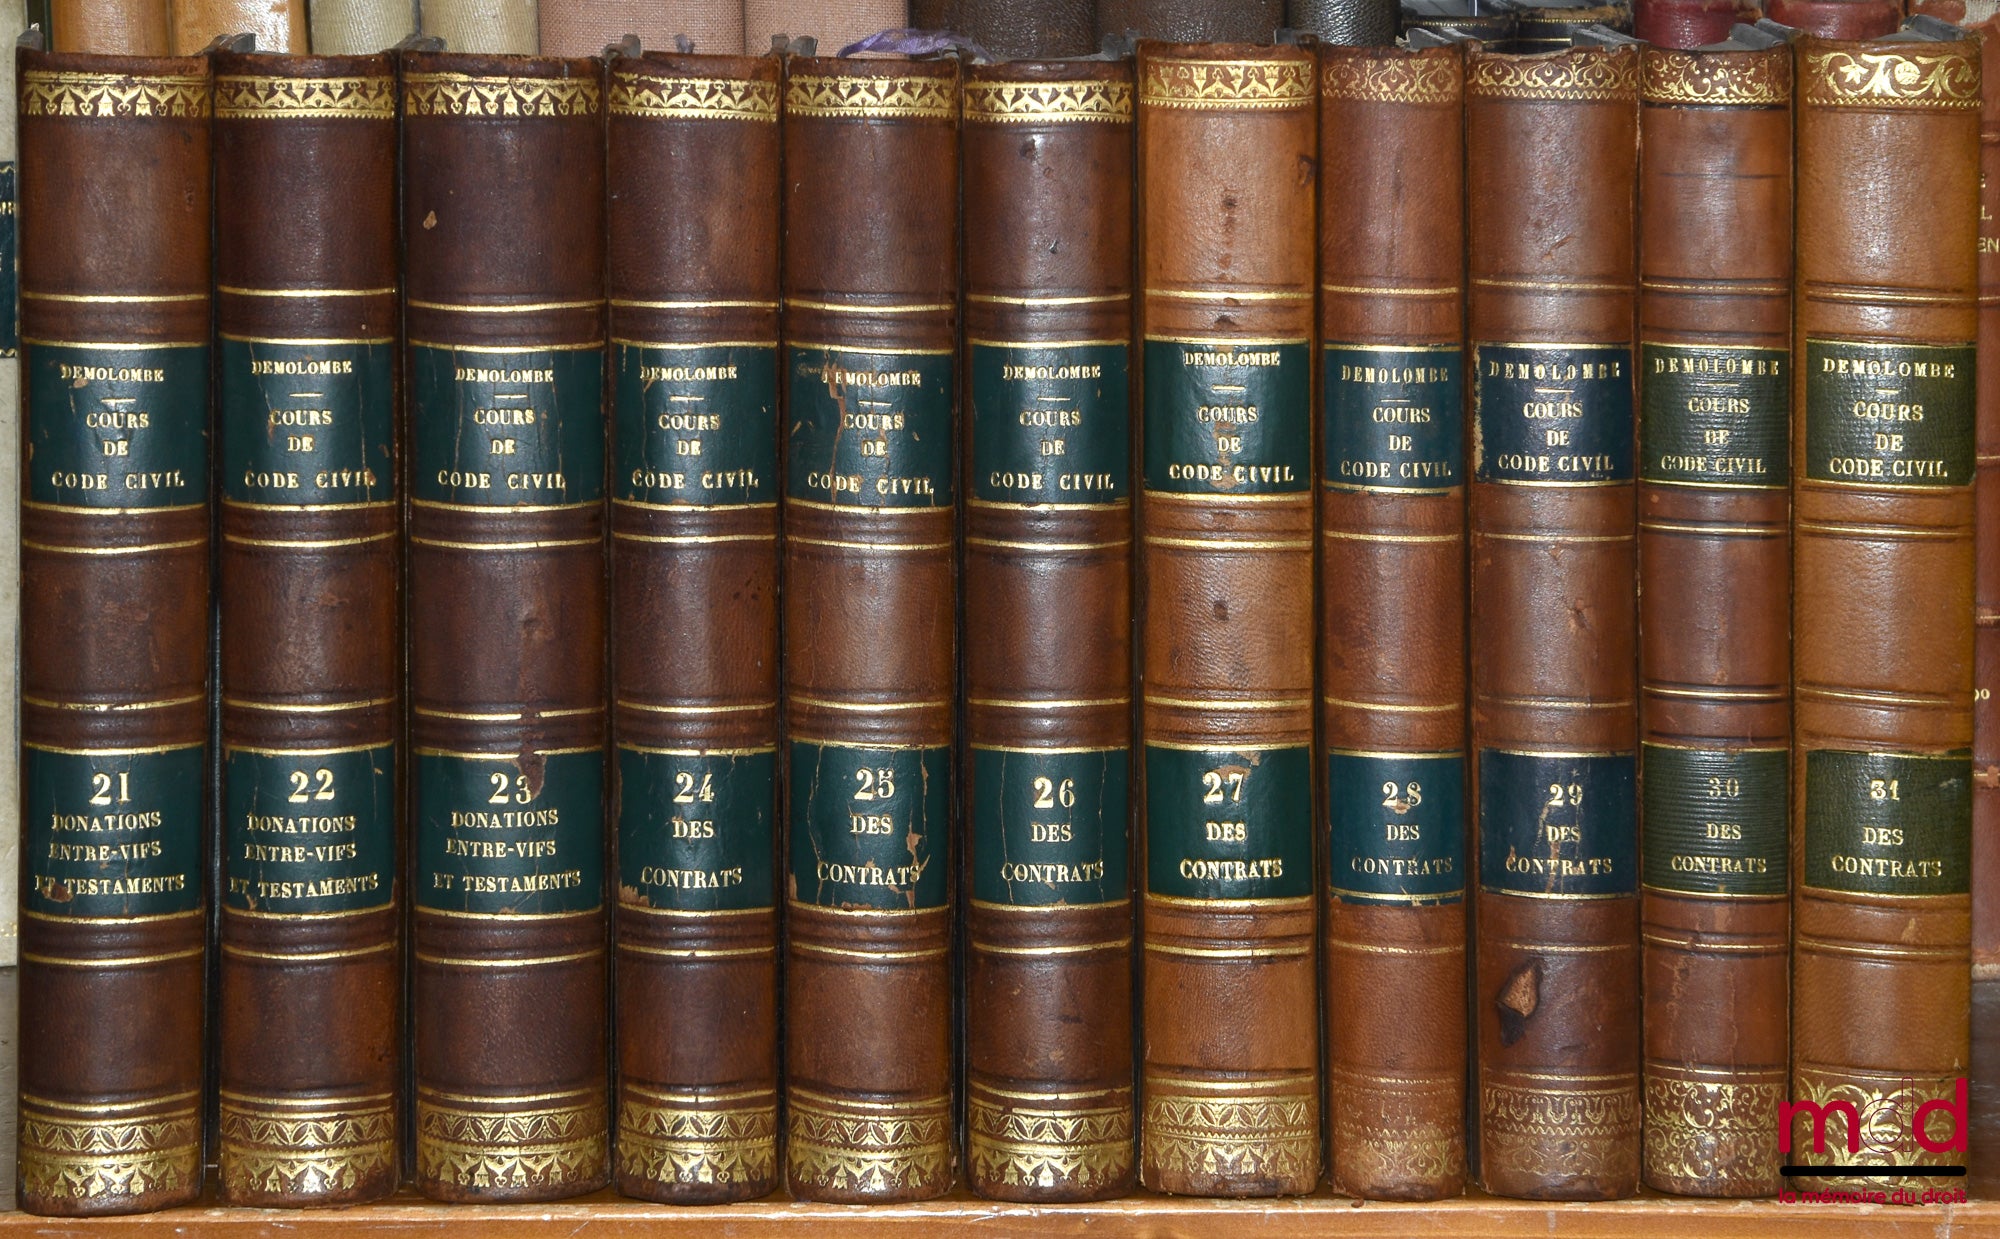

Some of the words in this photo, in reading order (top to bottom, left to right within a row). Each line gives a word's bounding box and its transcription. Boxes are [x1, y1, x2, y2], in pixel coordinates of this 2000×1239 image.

[252, 361, 352, 375] DEMOLOMBE
[1184, 352, 1280, 366] DEMOLOMBE
[1655, 358, 1778, 375] DEMOLOMBE
[1823, 358, 1954, 378] DEMOLOMBE
[61, 366, 164, 382] DEMOLOMBE
[455, 368, 553, 383] DEMOLOMBE
[640, 367, 737, 381] DEMOLOMBE
[1003, 366, 1101, 380] DEMOLOMBE
[1342, 365, 1448, 383] DEMOLOMBE
[1488, 361, 1620, 380] DEMOLOMBE
[1198, 406, 1258, 422] COURS
[1523, 402, 1583, 418] COURS
[1688, 397, 1750, 413] COURS
[1853, 401, 1923, 421] COURS
[86, 413, 149, 428] COURS
[270, 410, 332, 425] COURS
[474, 409, 535, 424] COURS
[658, 415, 720, 430] COURS
[844, 414, 904, 430] COURS
[1019, 411, 1081, 426] COURS
[1373, 408, 1430, 423] COURS
[288, 436, 314, 452] DE
[1218, 437, 1241, 452] DE
[1389, 435, 1412, 451] DE
[1547, 430, 1570, 446] DE
[1705, 430, 1729, 444] DE
[1876, 433, 1903, 451] DE
[103, 440, 128, 456] DE
[490, 439, 516, 454] DE
[677, 441, 701, 455] DE
[862, 441, 886, 455] DE
[1041, 440, 1065, 455] DE
[1341, 461, 1390, 478] CODE
[1400, 462, 1451, 478] CIVIL
[1498, 455, 1550, 472] CODE
[1558, 456, 1613, 472] CIVIL
[1661, 456, 1707, 471] CODE
[1715, 457, 1766, 473] CIVIL
[1830, 458, 1883, 476] CODE
[1893, 460, 1947, 477] CIVIL
[52, 472, 108, 489] CODE
[125, 470, 184, 489] CIVIL
[245, 471, 300, 488] CODE
[315, 469, 376, 488] CIVIL
[438, 470, 491, 488] CODE
[508, 473, 566, 489] CIVIL
[632, 471, 685, 488] CODE
[702, 471, 759, 488] CIVIL
[991, 472, 1043, 490] CODE
[1060, 474, 1114, 490] CIVIL
[1169, 464, 1222, 481] CODE
[1233, 466, 1294, 483] CIVIL
[808, 473, 860, 492] CODE
[877, 478, 934, 494] CIVIL
[89, 772, 131, 805] 21
[288, 769, 335, 803] 22
[488, 773, 531, 804] 23
[673, 772, 715, 803] 24
[854, 769, 894, 800] 25
[1034, 777, 1075, 808] 26
[1203, 772, 1244, 803] 27
[1709, 777, 1740, 797] 30
[1870, 780, 1900, 800] 31
[1382, 782, 1422, 806] 28
[1549, 784, 1583, 806] 29
[51, 812, 162, 832] DONATIONS
[247, 815, 356, 833] DONATIONS
[451, 809, 559, 828] DONATIONS
[850, 816, 892, 834] DES
[672, 820, 714, 838] DES
[1031, 824, 1072, 842] DES
[1206, 822, 1247, 841] DES
[1387, 825, 1420, 841] DES
[1546, 825, 1581, 842] DES
[1706, 823, 1741, 840] DES
[1862, 827, 1904, 845] DES
[48, 841, 162, 862] ENTRE-VIFS
[244, 843, 356, 862] ENTRE-VIFS
[446, 838, 556, 858] ENTRE-VIFS
[1001, 861, 1103, 882] CONTRATS
[1180, 859, 1283, 880] CONTRATS
[1352, 857, 1452, 876] CONTRATS
[1505, 858, 1612, 875] CONTRATS
[1671, 856, 1767, 873] CONTRATS
[1832, 855, 1942, 877] CONTRATS
[433, 873, 454, 889] ET
[463, 871, 581, 892] TESTAMENTS
[641, 866, 742, 888] CONTRATS
[818, 864, 920, 885] CONTRATS
[64, 874, 185, 895] TESTAMENTS
[230, 878, 249, 893] ET
[258, 873, 378, 898] TESTAMENTS
